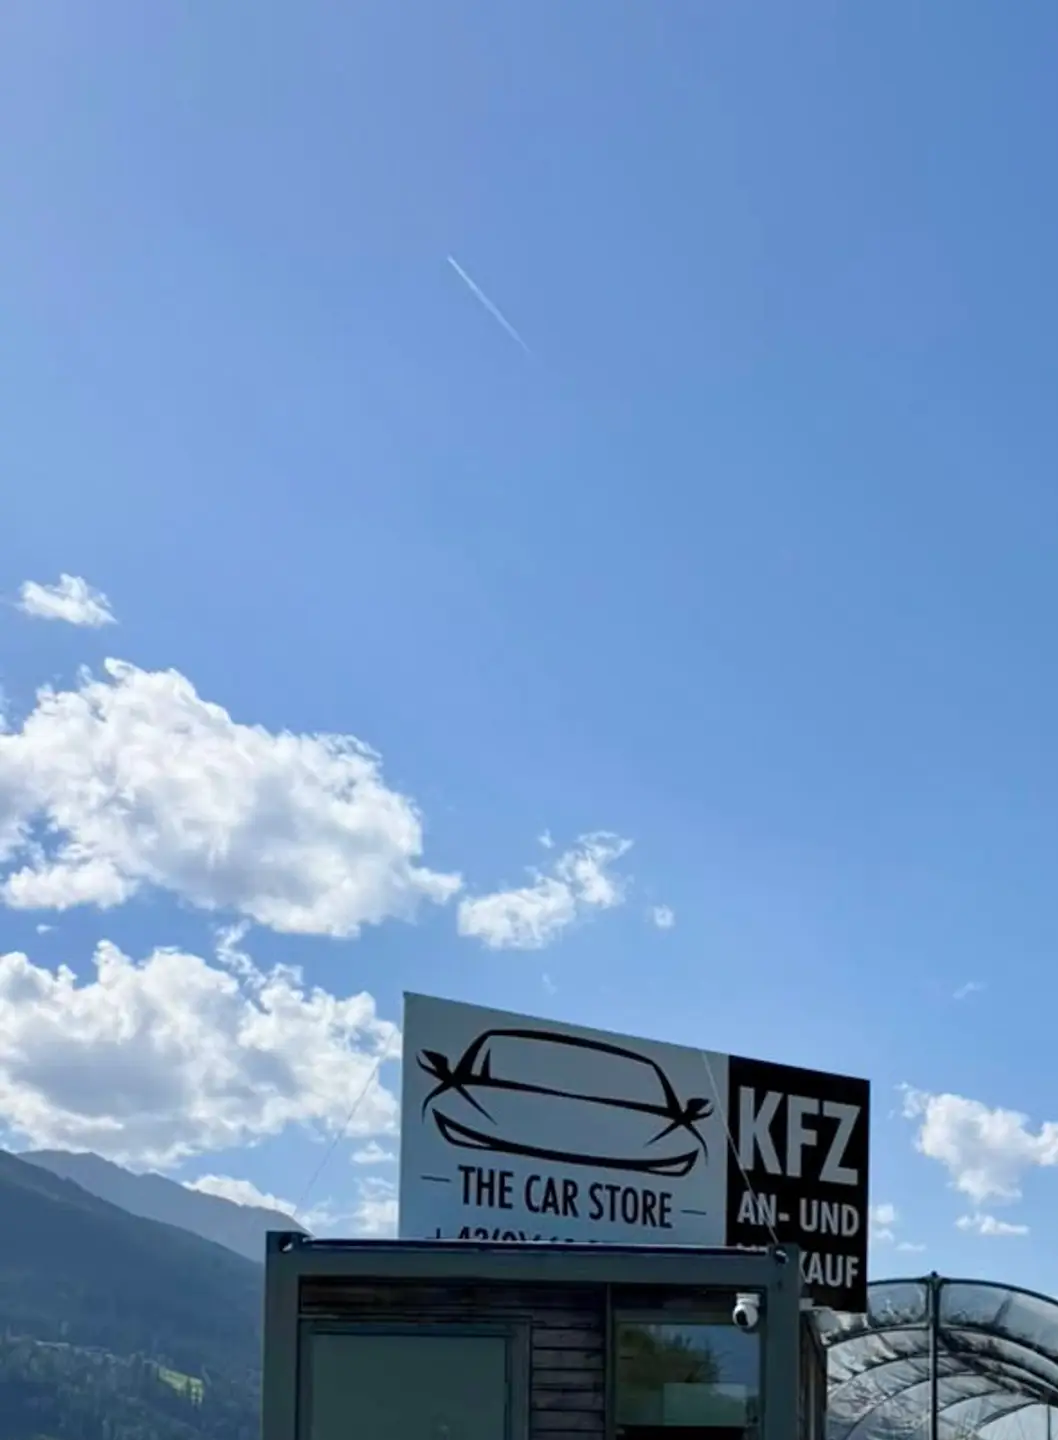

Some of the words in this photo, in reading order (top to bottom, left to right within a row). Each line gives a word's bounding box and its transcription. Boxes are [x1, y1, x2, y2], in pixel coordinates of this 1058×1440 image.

[738, 1085, 861, 1186] KFZ
[458, 1164, 514, 1210] THE
[524, 1174, 579, 1218] CAR
[589, 1182, 673, 1229] STORE
[737, 1190, 790, 1228] AN-
[799, 1197, 859, 1237] UND
